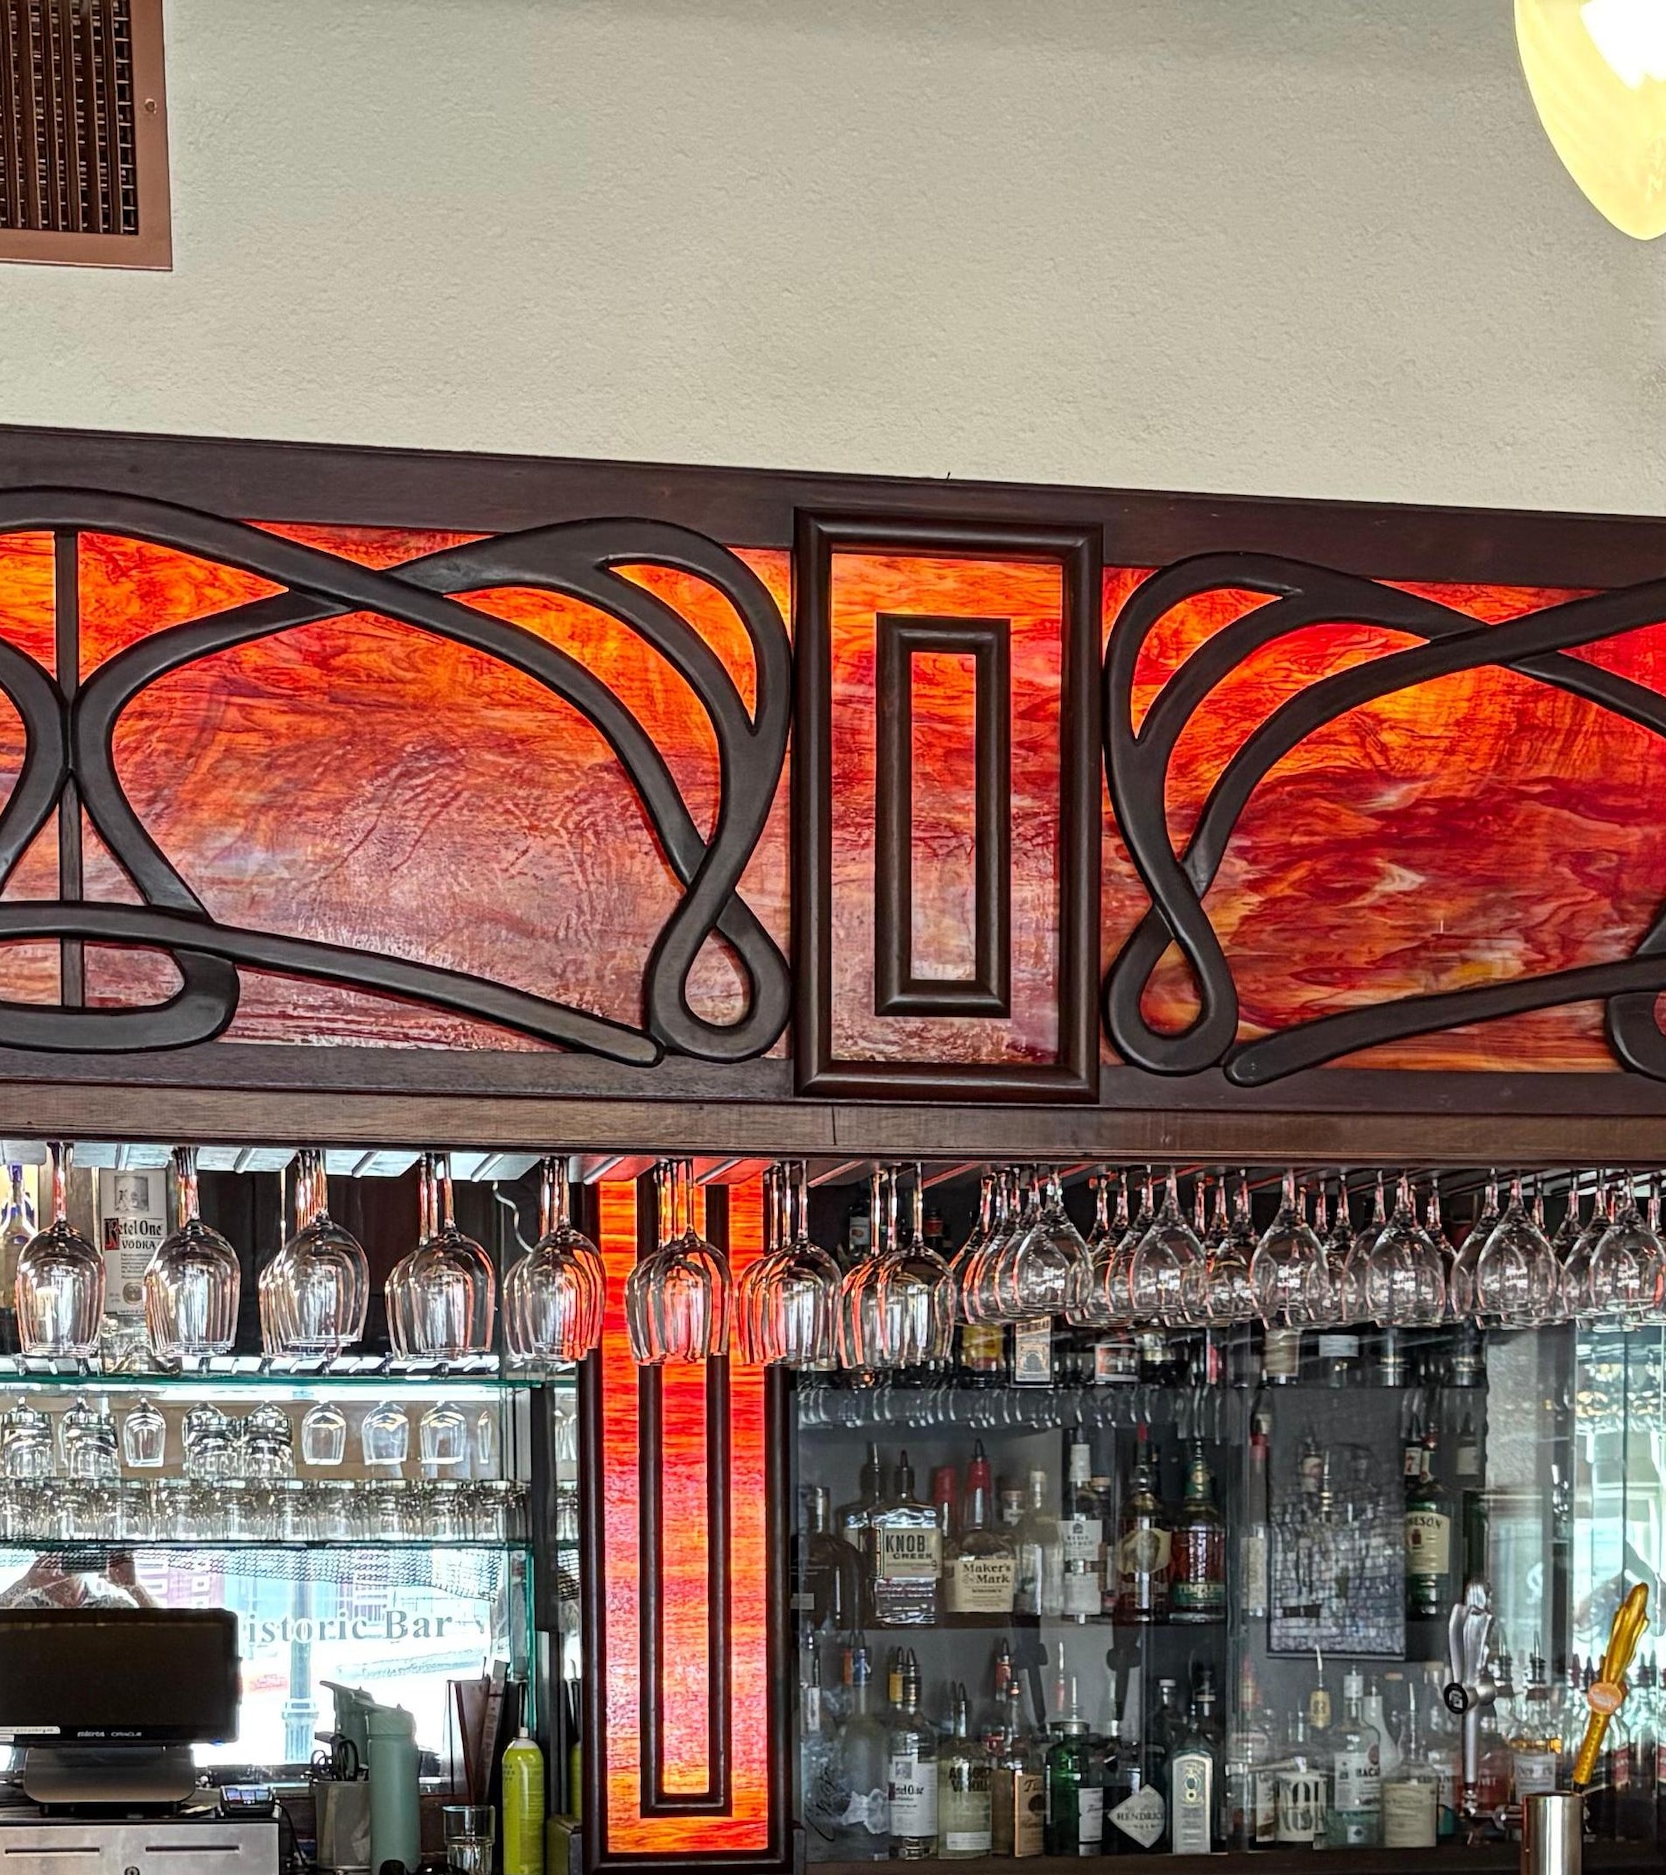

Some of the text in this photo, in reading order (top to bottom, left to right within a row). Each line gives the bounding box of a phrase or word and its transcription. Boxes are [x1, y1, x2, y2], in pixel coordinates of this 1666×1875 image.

[139, 1219, 162, 1237] One
[121, 1240, 156, 1250] VODKA
[885, 1534, 926, 1552] KNOB
[892, 1552, 933, 1560] CREEK
[962, 1563, 1012, 1573] Maker's
[975, 1574, 1011, 1584] Mark
[247, 1609, 453, 1644] istoric Bar
